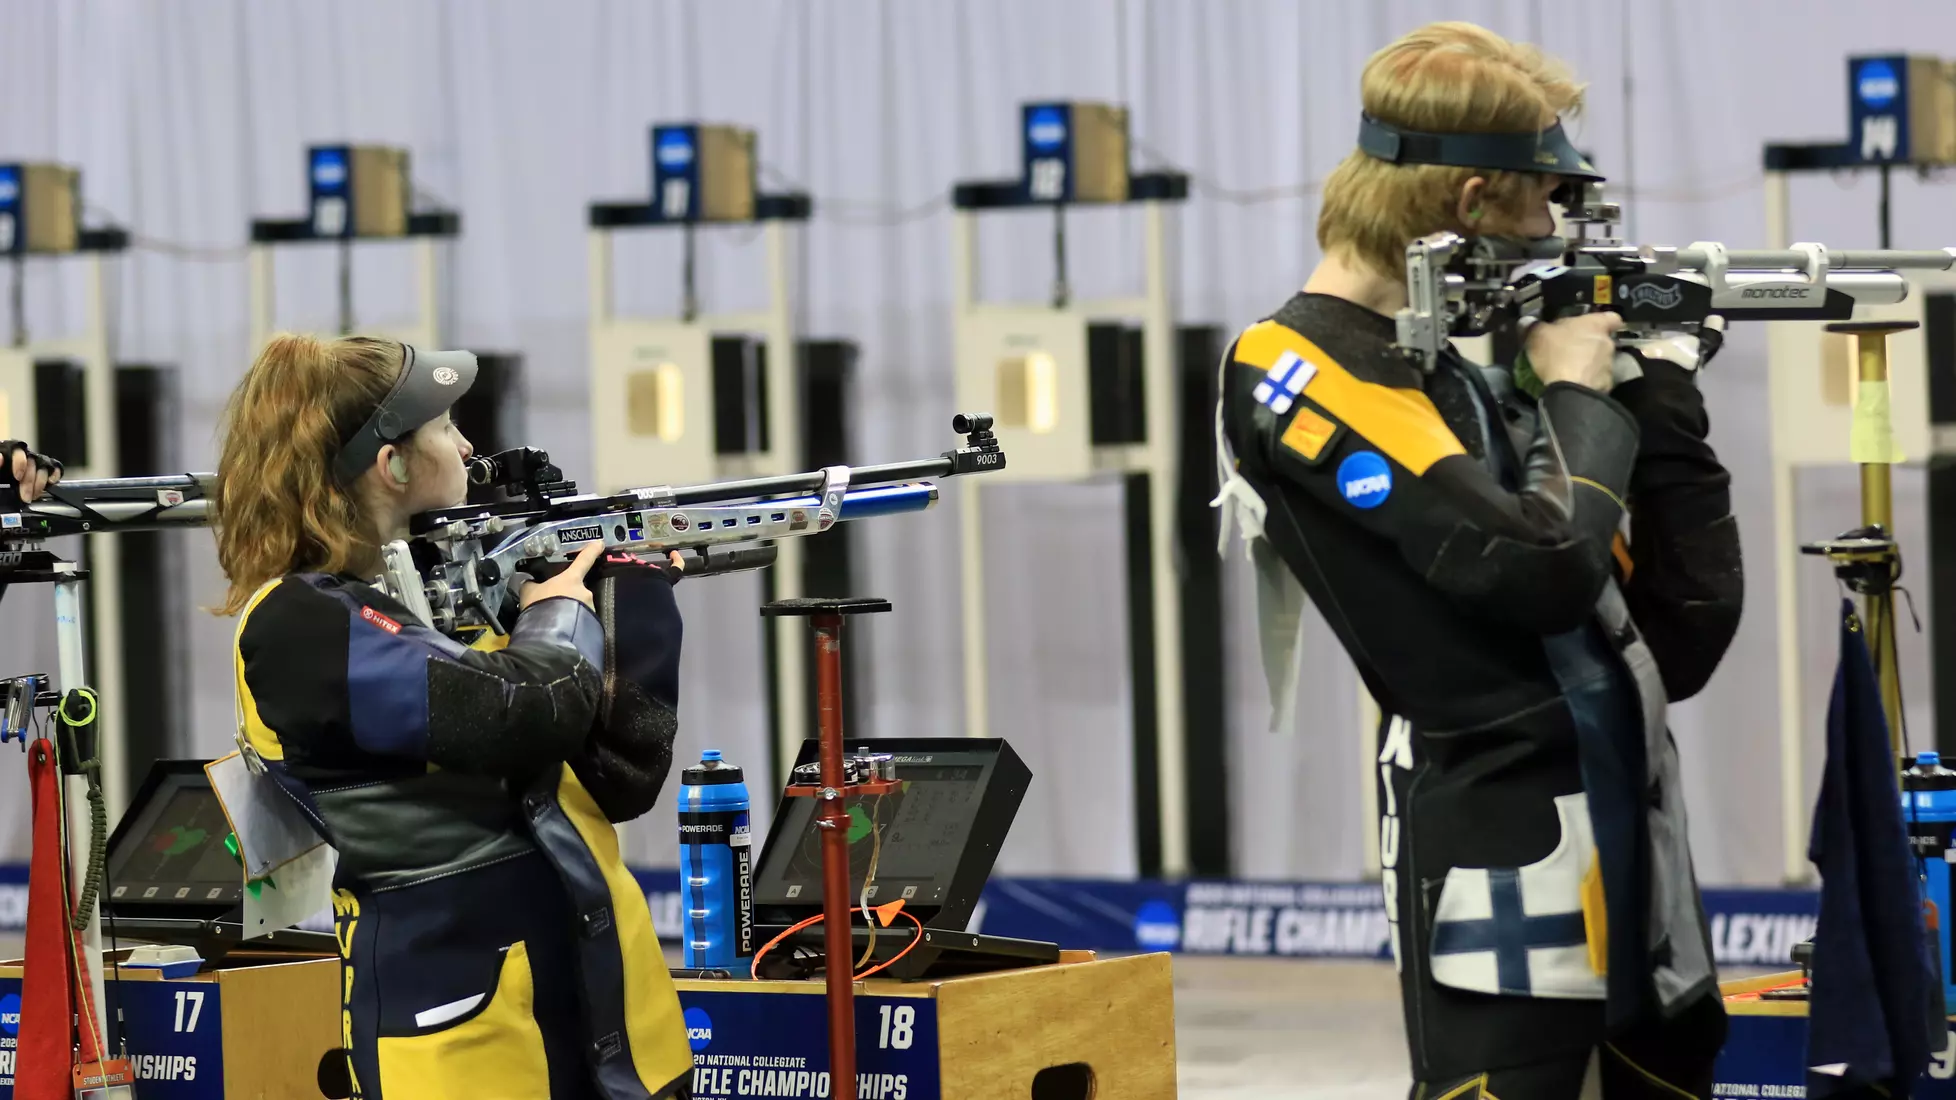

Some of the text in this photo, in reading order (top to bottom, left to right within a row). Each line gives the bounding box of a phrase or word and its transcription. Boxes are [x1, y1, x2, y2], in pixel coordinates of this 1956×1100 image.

[1741, 287, 1810, 299] monotec
[977, 453, 997, 466] 9003
[681, 823, 724, 833] POWERADE
[739, 851, 752, 953] POWERADE
[1184, 906, 1272, 953] RIFLE
[174, 991, 205, 1033] 17
[879, 1005, 915, 1050] 18
[707, 1054, 751, 1067] NATIONAL
[753, 1056, 806, 1069] COLLEGIATE
[1711, 1083, 1760, 1096] ATIONAL
